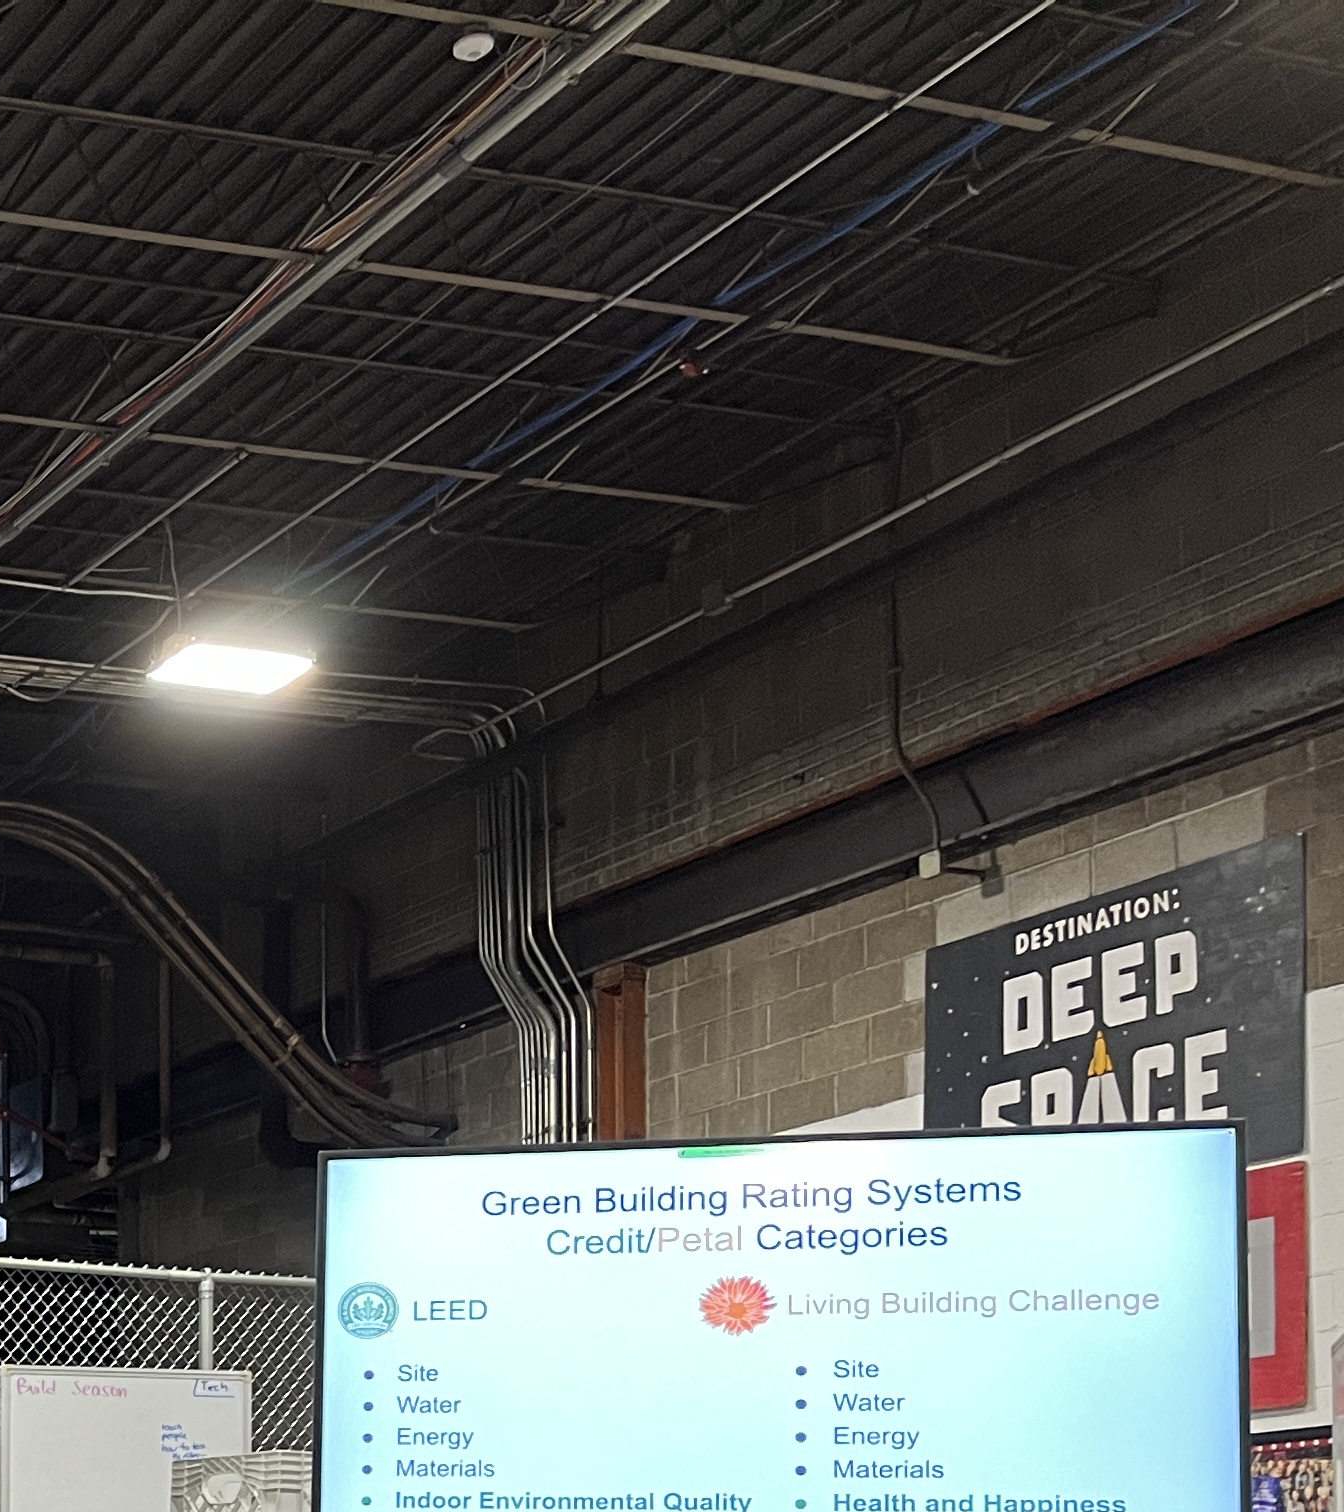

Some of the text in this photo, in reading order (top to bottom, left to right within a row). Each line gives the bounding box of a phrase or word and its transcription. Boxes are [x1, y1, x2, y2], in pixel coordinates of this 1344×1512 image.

[1014, 887, 1182, 957] DESTINATION:
[1002, 930, 1199, 1056] DEEP
[482, 1178, 1021, 1216] Green Building Rating Systems
[547, 1221, 947, 1255] Credit/Petal Categories
[414, 1300, 487, 1321] LEED
[789, 1289, 1160, 1320] Living Building Challenge
[398, 1364, 438, 1382] Site
[834, 1360, 879, 1378] Site
[17, 1378, 128, 1398] Build Season
[200, 1382, 229, 1393] Tech
[397, 1396, 461, 1413] Water
[833, 1394, 905, 1411] Water
[398, 1428, 474, 1450] Energy
[834, 1427, 920, 1450] Energy
[397, 1460, 495, 1477] Materials
[834, 1460, 944, 1478] Materials
[396, 1492, 471, 1509] Indoor
[480, 1492, 654, 1510] Environmental
[834, 1494, 915, 1512] Health
[926, 1494, 973, 1512] and
